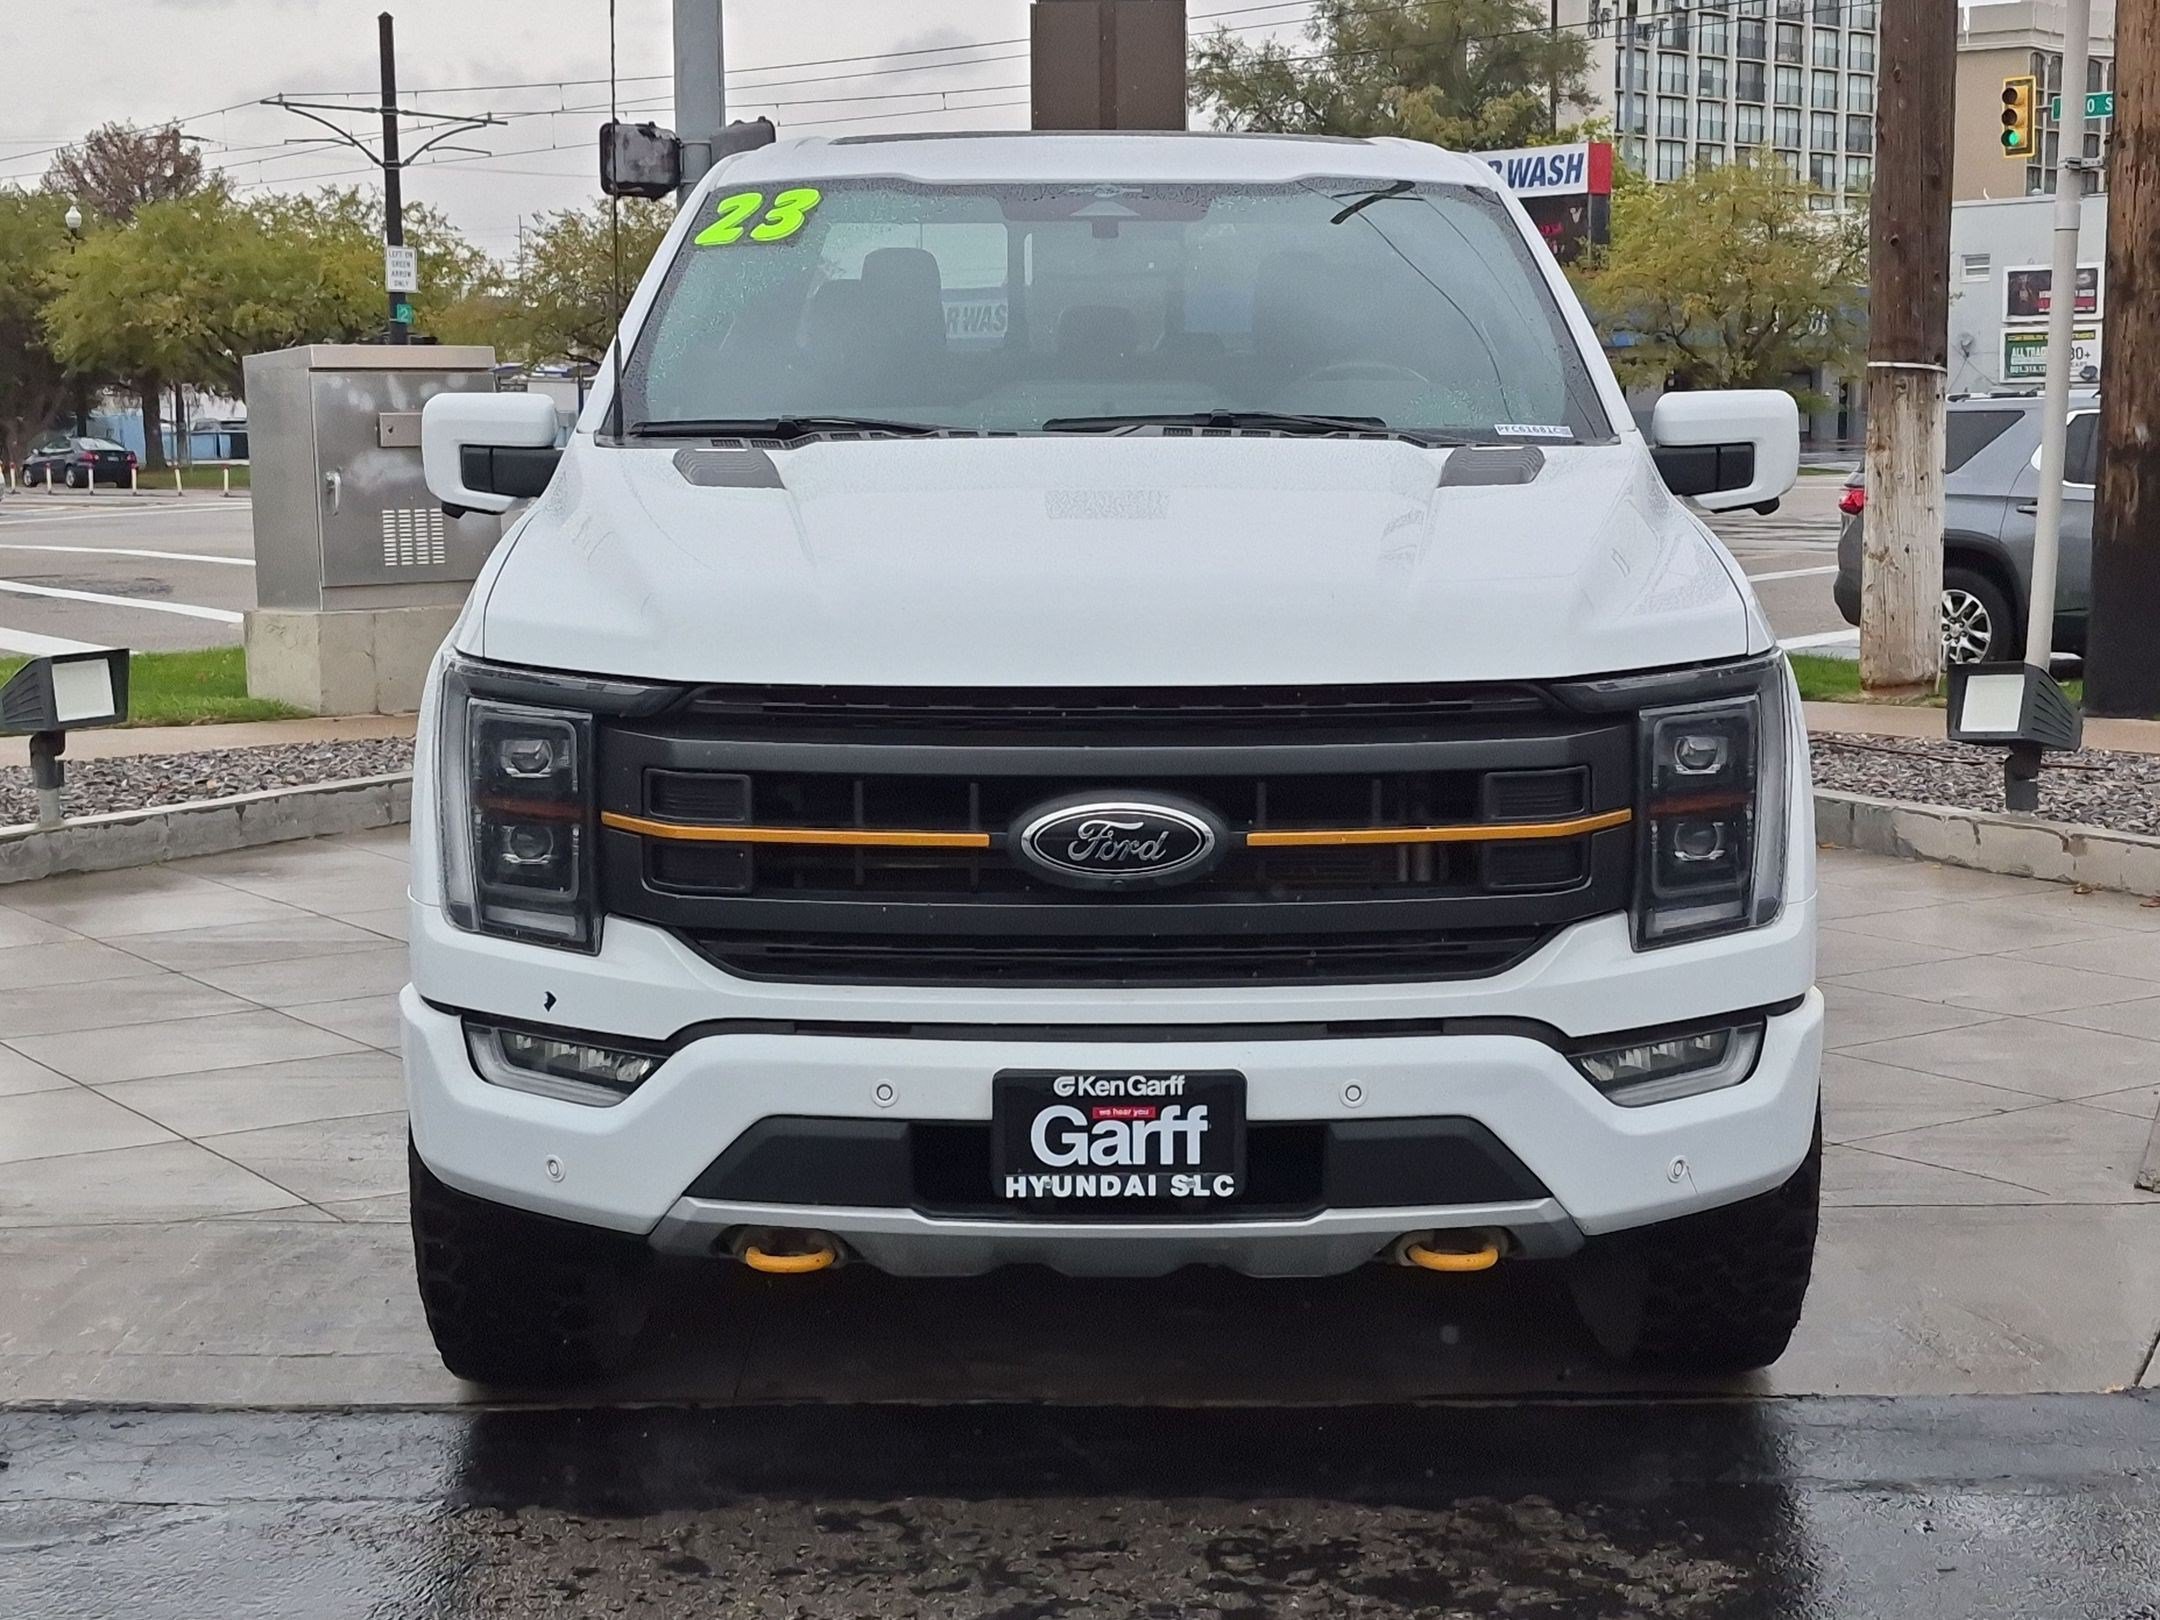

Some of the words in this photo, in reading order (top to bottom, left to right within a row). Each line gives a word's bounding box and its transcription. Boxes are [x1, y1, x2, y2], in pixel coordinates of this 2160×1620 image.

[1507, 152, 1585, 189] WASH
[694, 188, 822, 247] 23
[388, 250, 403, 258] LEFT
[404, 250, 413, 259] ON
[1067, 819, 1169, 862] Ford
[1077, 1075, 1125, 1097] Ken
[1126, 1074, 1186, 1097] Garff
[1098, 1108, 1111, 1116] we
[1112, 1106, 1131, 1116] hear
[1132, 1108, 1149, 1117] you
[1030, 1104, 1208, 1168] Garff
[1005, 1174, 1157, 1198] HYUNDAI
[1170, 1174, 1235, 1198] SLC
